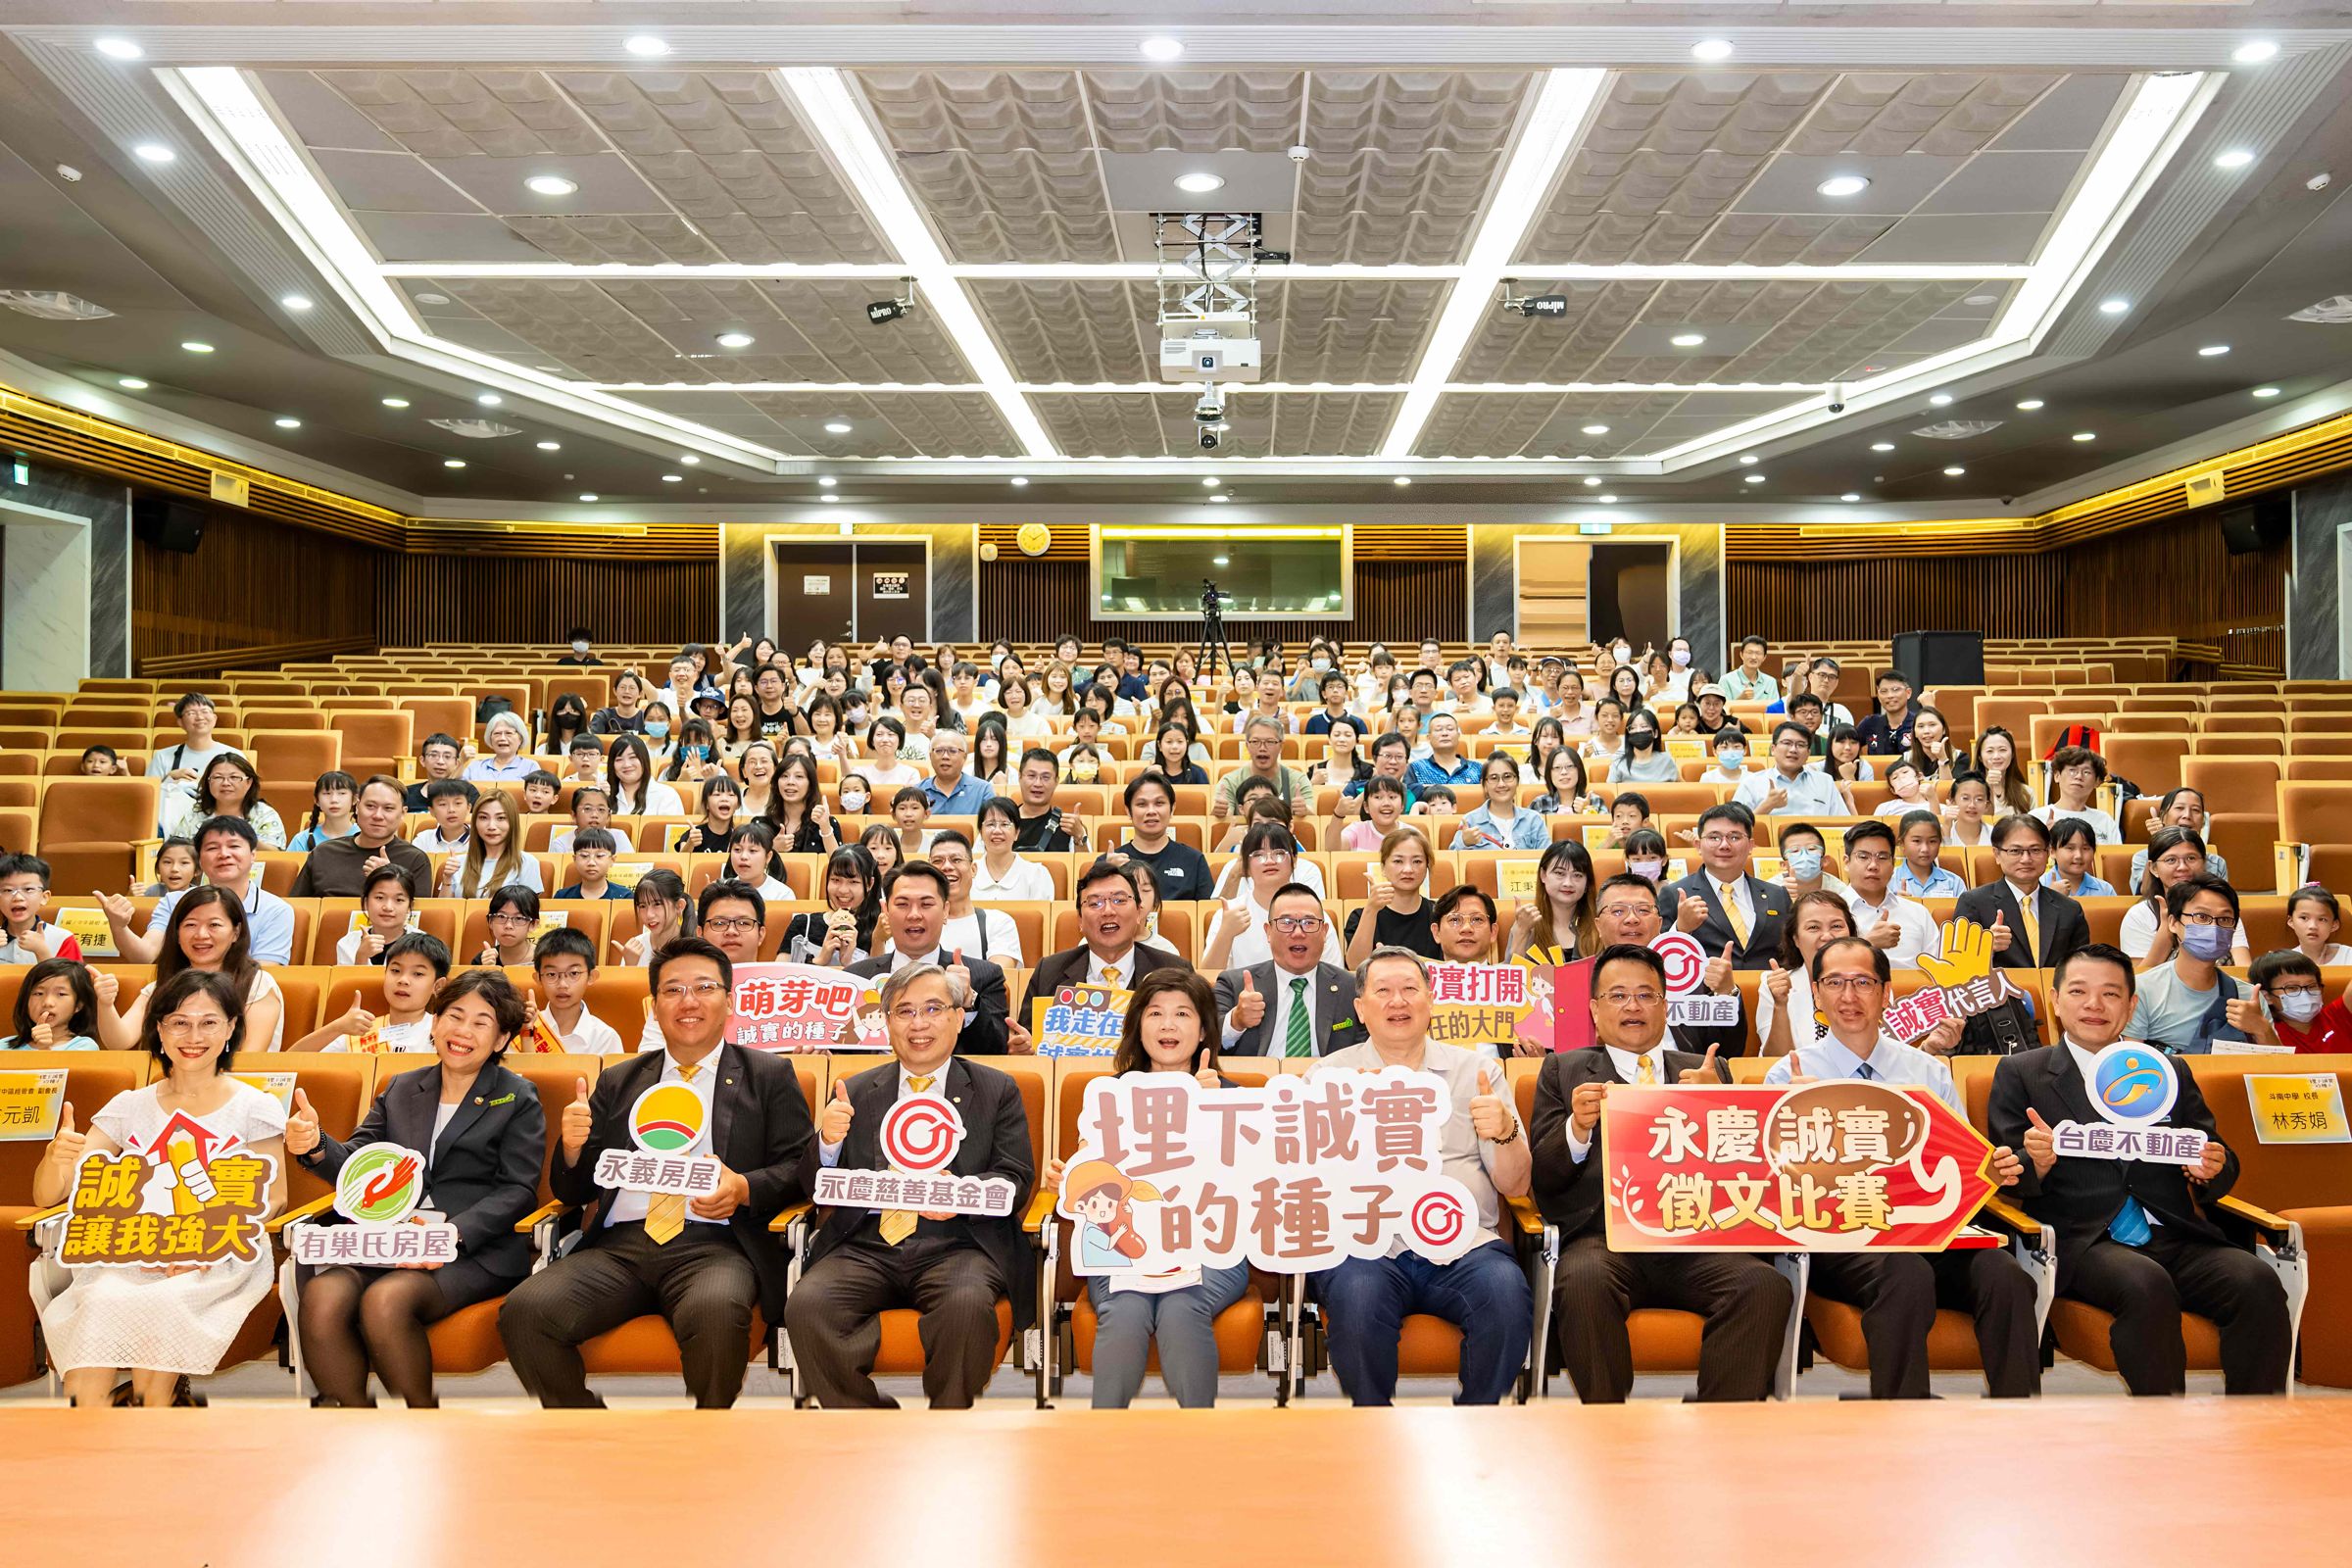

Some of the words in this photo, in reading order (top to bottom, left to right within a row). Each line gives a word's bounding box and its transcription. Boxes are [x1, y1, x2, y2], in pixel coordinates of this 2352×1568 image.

[740, 980, 854, 1016] 萌芽吧
[1882, 970, 2022, 1041] 誠實代言人
[737, 1020, 848, 1046] 誠實的種子
[1045, 1007, 1125, 1037] 我走在
[0, 1105, 40, 1124] 元凱
[1093, 1080, 1438, 1176] 埋下誠實
[2272, 1111, 2328, 1130] 林秀娟
[2059, 1126, 2202, 1159] 台慶不動產
[600, 1154, 715, 1191] 永義房屋
[819, 1174, 1009, 1210] 永慶慈善基金會
[1656, 1171, 1894, 1232] 徵文比賽
[64, 1213, 252, 1256] 讓我強大
[1160, 1176, 1402, 1258] 的種子
[299, 1230, 450, 1258] 有巢氏房屋
